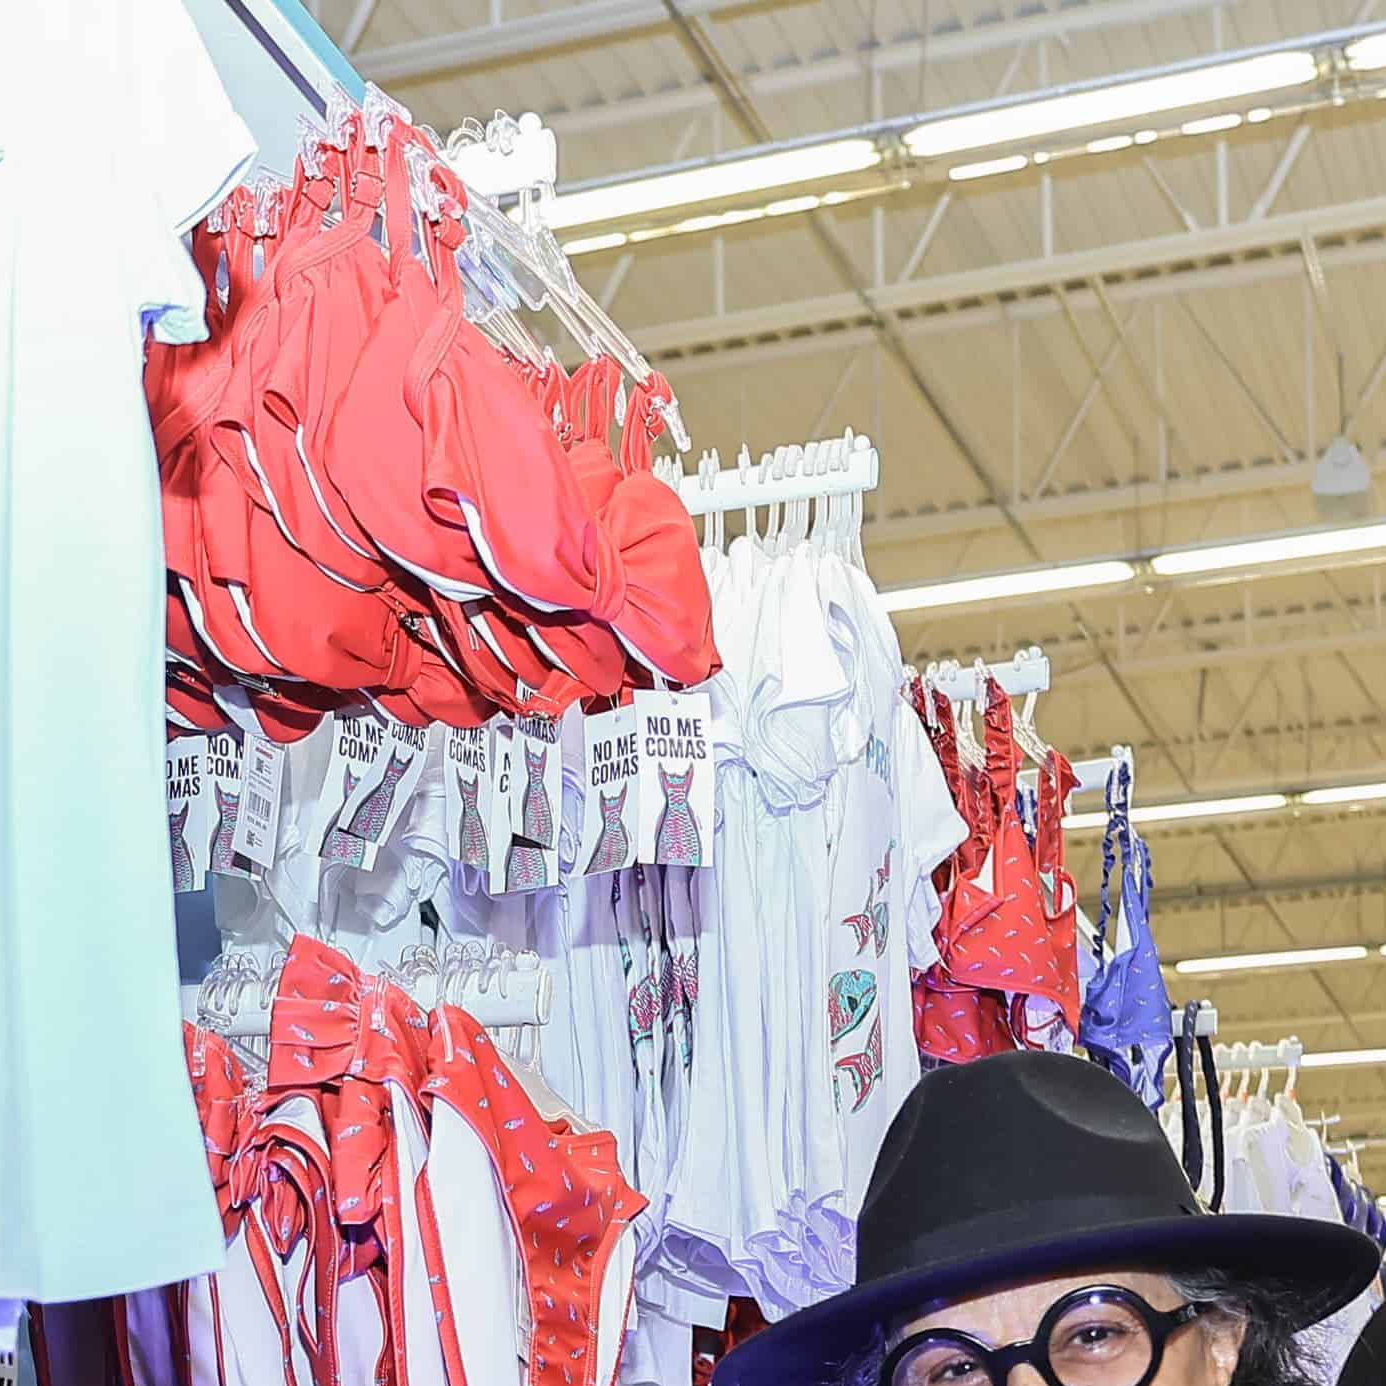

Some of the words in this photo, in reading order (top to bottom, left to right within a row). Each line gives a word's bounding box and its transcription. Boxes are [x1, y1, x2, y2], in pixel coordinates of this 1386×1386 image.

[342, 714, 361, 738] NO
[365, 723, 384, 746] ME
[391, 723, 426, 751] COMAS
[469, 728, 485, 750] ME
[646, 716, 671, 736] NO
[677, 718, 703, 738] ME
[207, 737, 229, 757] NO
[449, 739, 486, 773] COMAS
[593, 740, 612, 765] NO
[617, 732, 638, 758] ME
[645, 737, 706, 760] COMAS
[178, 755, 200, 778] ME
[206, 756, 243, 780] COM
[591, 755, 639, 786] COMAS
[166, 776, 201, 800] MAS
